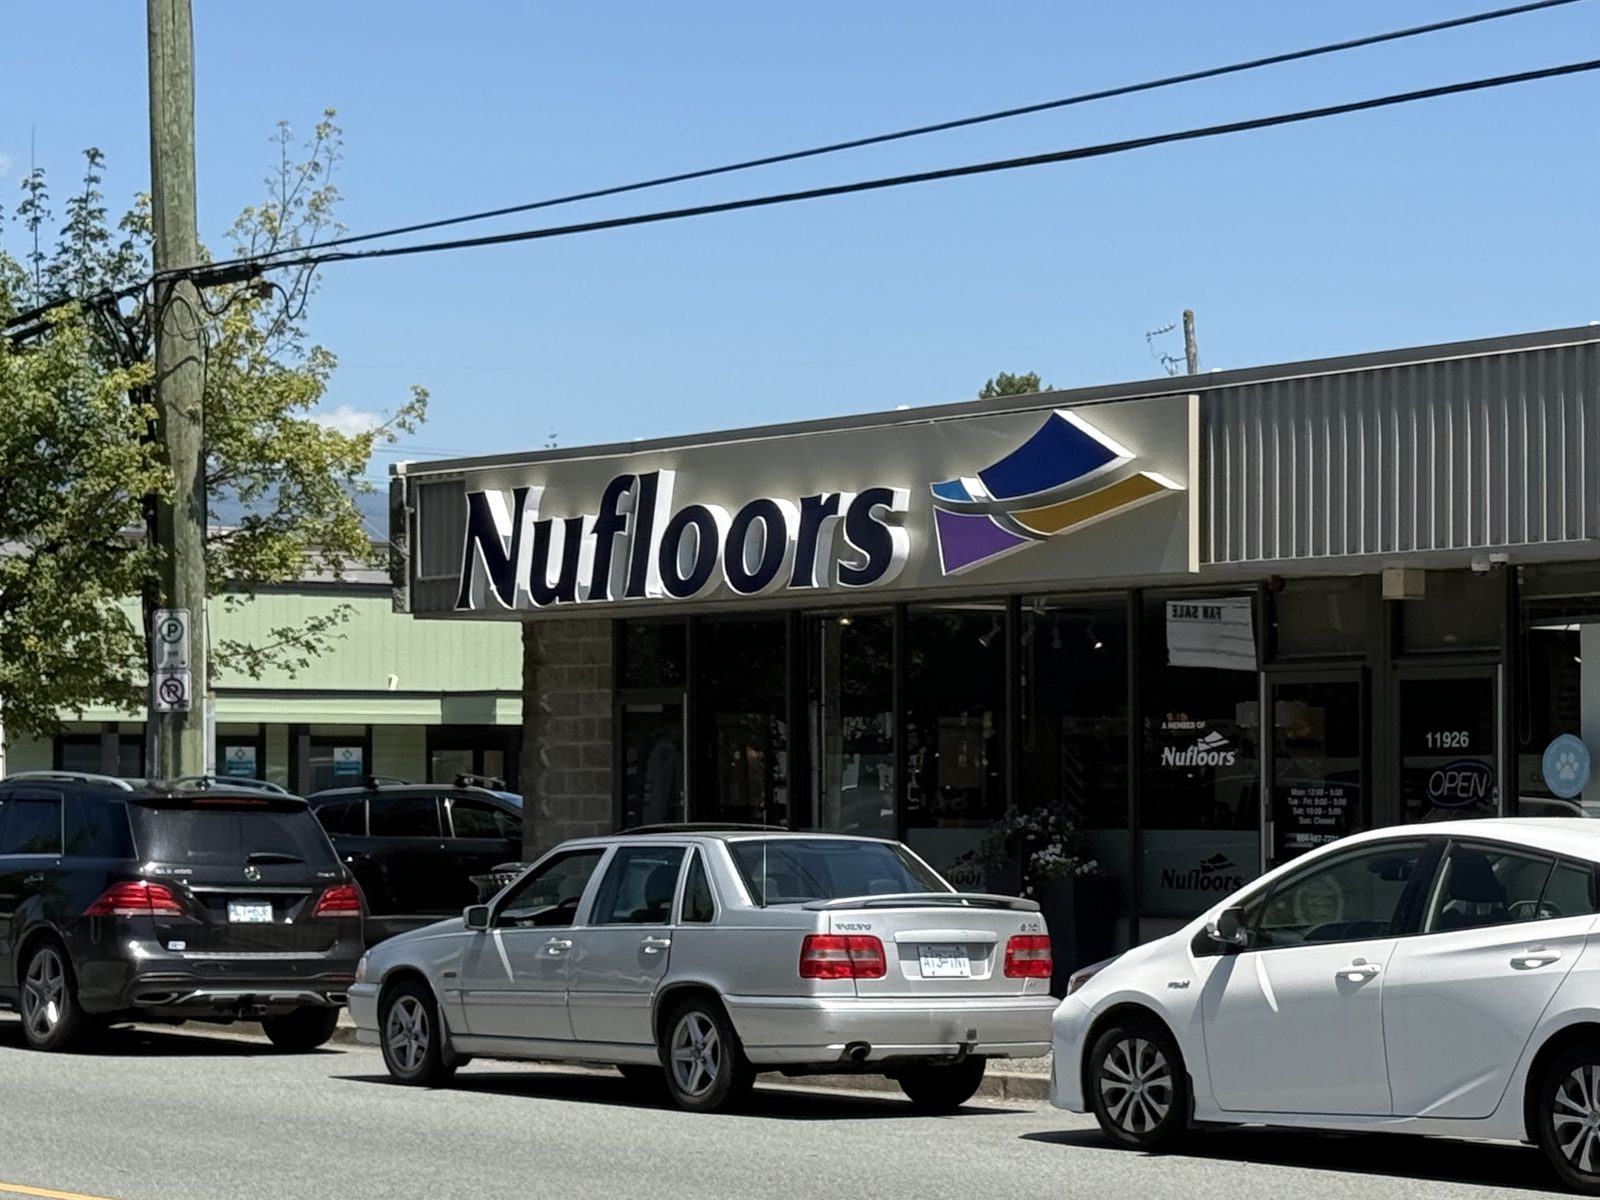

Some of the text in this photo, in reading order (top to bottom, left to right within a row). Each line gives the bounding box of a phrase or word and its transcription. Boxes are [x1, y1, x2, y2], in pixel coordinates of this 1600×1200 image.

[453, 469, 911, 610] Nufloors
[1426, 731, 1469, 748] 11926
[1161, 745, 1236, 766] Nufloors
[1429, 771, 1488, 797] OPEN
[1161, 868, 1243, 891] Nufloors
[835, 923, 872, 931] VOLVO
